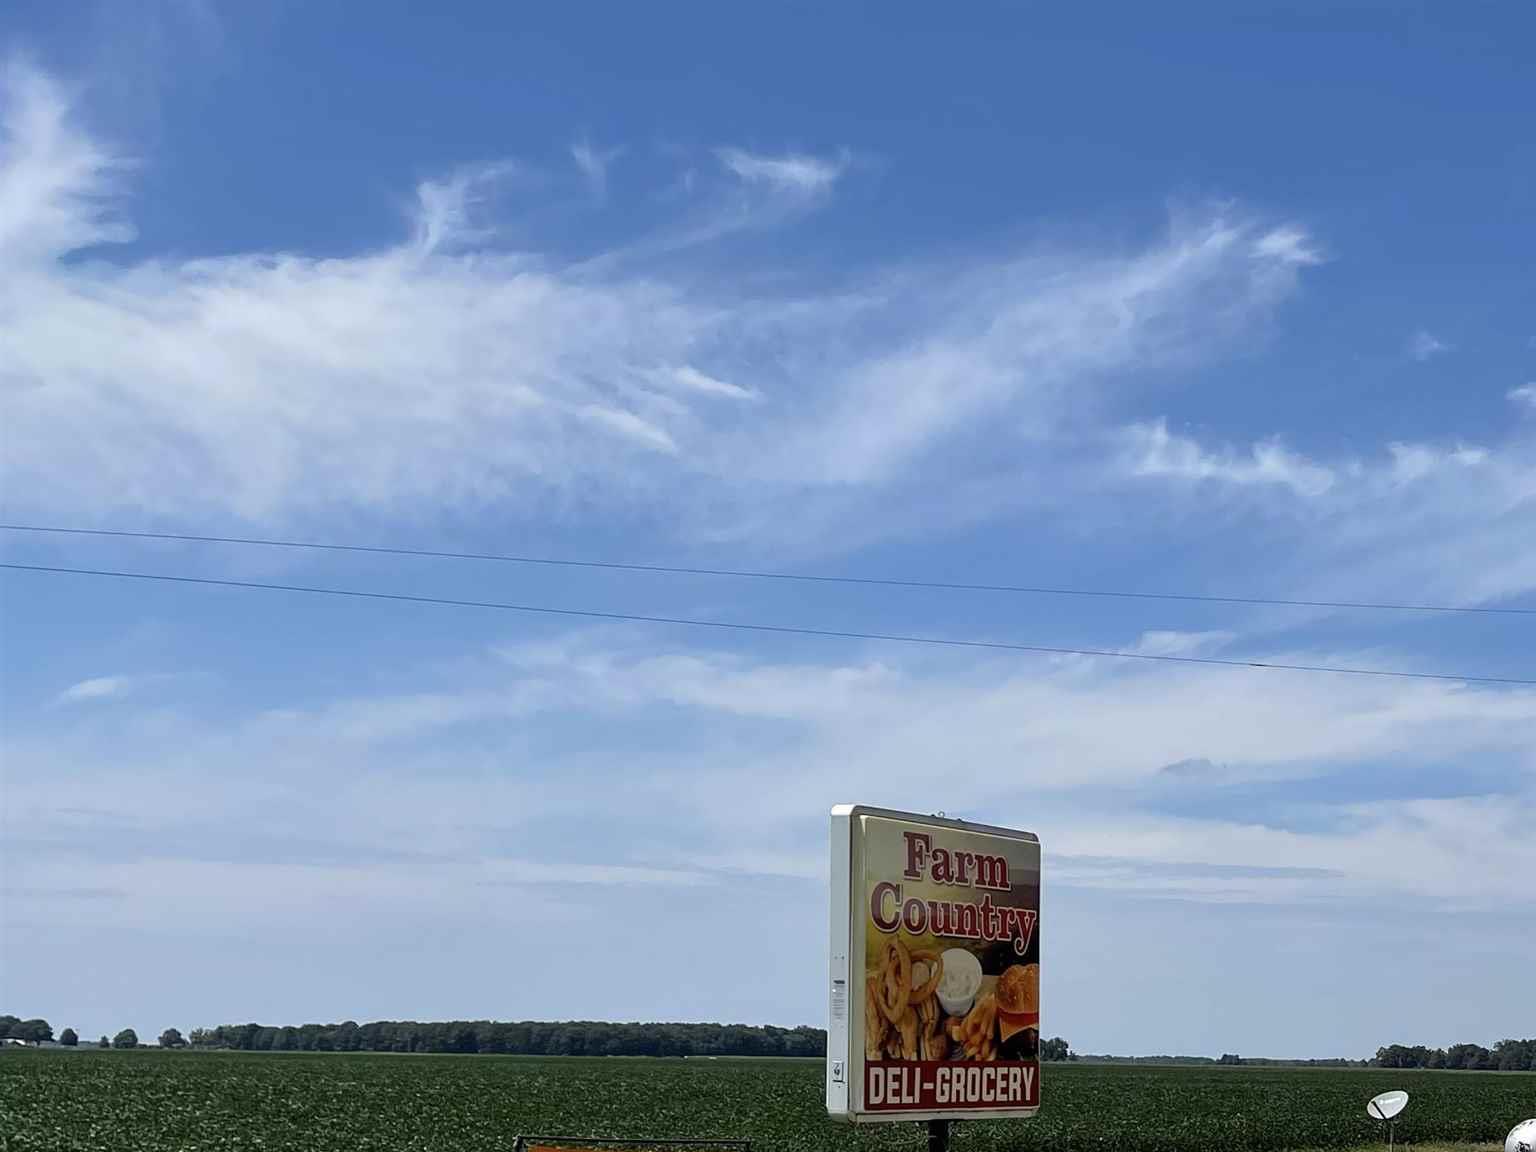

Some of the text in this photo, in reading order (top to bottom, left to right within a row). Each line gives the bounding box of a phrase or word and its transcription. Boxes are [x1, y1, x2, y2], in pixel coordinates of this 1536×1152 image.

[903, 831, 1010, 891] Farm
[870, 881, 1037, 956] Country
[869, 1066, 1035, 1105] DELI-GROCERY
